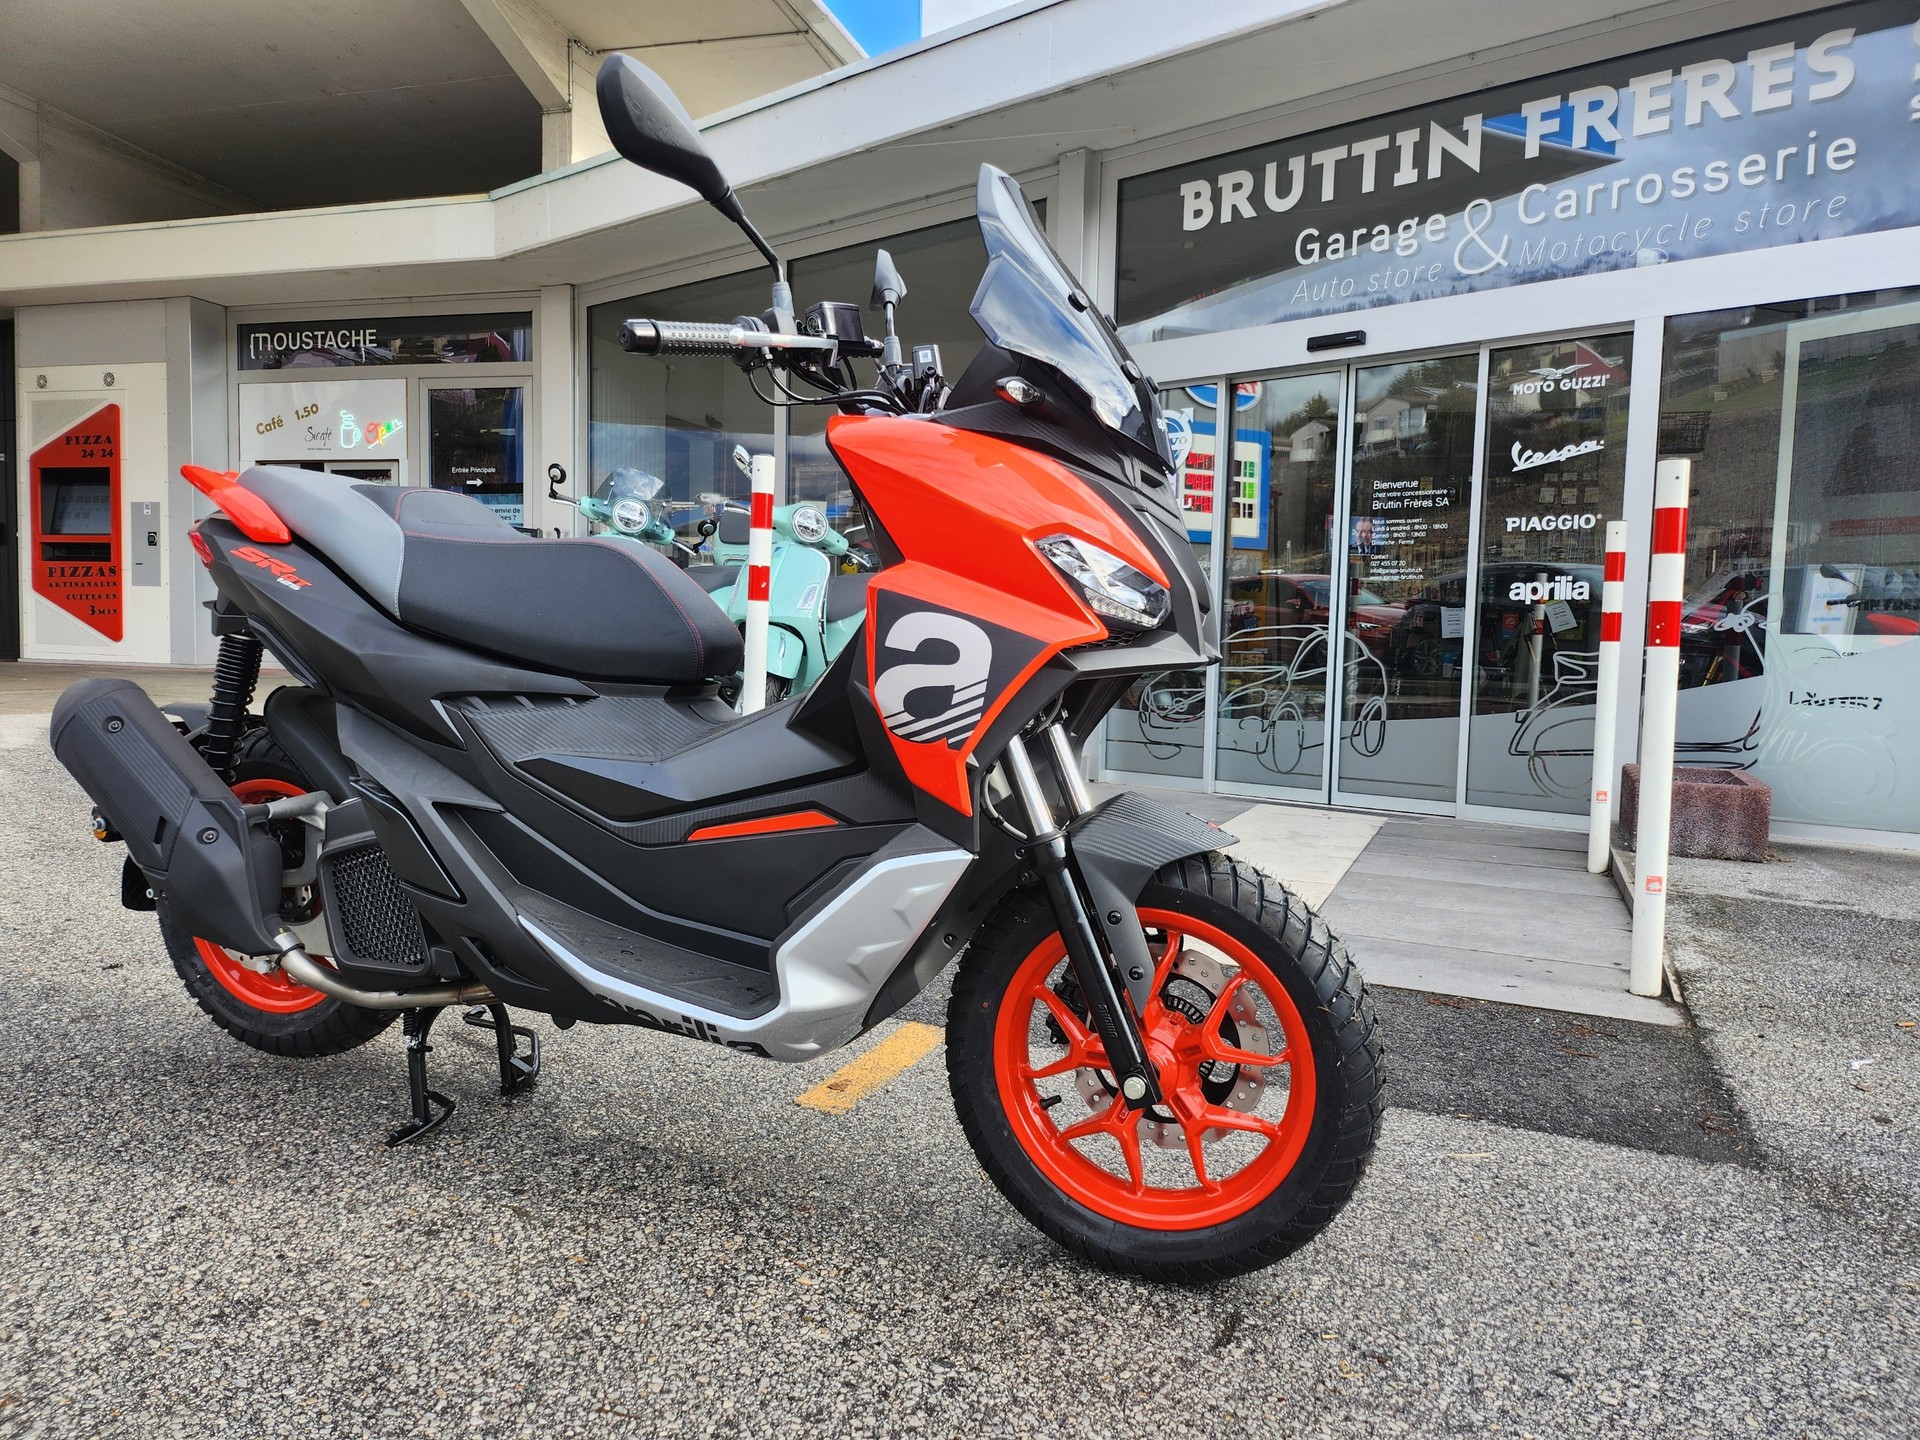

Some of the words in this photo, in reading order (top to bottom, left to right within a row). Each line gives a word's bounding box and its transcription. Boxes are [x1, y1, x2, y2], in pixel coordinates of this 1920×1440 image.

[1180, 113, 1483, 232] BRUTTIN
[1521, 28, 1857, 159] FRERES
[1295, 212, 1447, 266] Garage
[1454, 198, 1510, 275] &
[1517, 130, 1857, 225] Carrosserie
[1518, 213, 1713, 267] Motocycle
[1733, 194, 1847, 232] store
[1290, 279, 1355, 304] Auto
[1368, 262, 1444, 293] store
[250, 329, 378, 357] MOUSTACHE
[1512, 380, 1555, 396] MOTO
[1560, 374, 1607, 391] GUZZI
[256, 415, 284, 435] Café
[294, 403, 319, 421] 1.50
[64, 434, 114, 446] PIZZA
[304, 426, 333, 447] Sicafé
[364, 418, 403, 445] Open
[81, 448, 114, 459] 24/24
[1511, 440, 1605, 473] Vespa
[451, 466, 469, 474] Entrée
[470, 466, 496, 475] Principale
[1373, 480, 1419, 490] Bienvenue
[1402, 488, 1448, 497] concessionnaire
[513, 506, 521, 514] de
[1372, 499, 1402, 510] Bruttin
[1404, 498, 1433, 508] Frères
[1435, 497, 1450, 507] SA
[1505, 514, 1597, 532] PIAGGIO
[47, 566, 117, 578] PIZZAS
[66, 593, 102, 601] CUITES
[1509, 576, 1590, 605] aprilia
